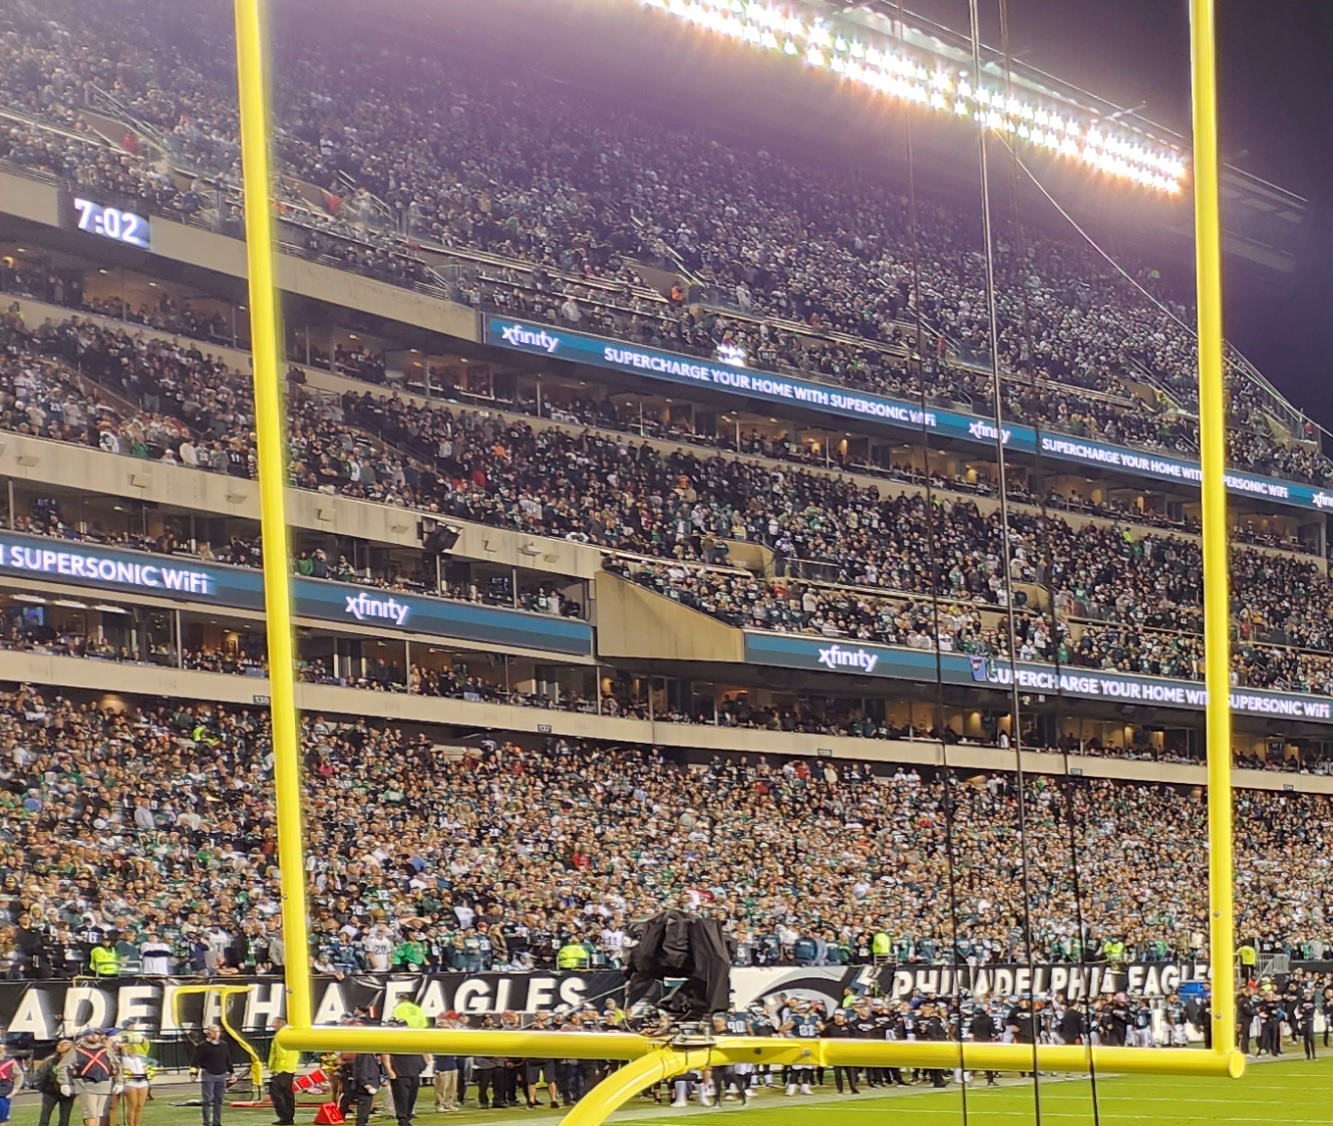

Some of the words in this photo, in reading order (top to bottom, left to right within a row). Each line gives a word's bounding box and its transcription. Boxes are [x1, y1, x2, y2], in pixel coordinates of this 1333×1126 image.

[74, 198, 140, 243] 7:02
[502, 325, 560, 353] xfinity
[604, 347, 711, 382] SUPERCHARGE
[711, 369, 751, 389] YOUR
[752, 378, 794, 400] HOME
[795, 386, 829, 406] WITH
[830, 393, 910, 422] SUPERSONIC
[969, 421, 1012, 445] xfiniy
[1042, 437, 1120, 466] SUPERCHARGE
[1121, 455, 1150, 471] YOUR
[1151, 462, 1181, 478] HOME
[1269, 484, 1289, 499] WiFi
[11, 545, 160, 586] SUPERSONIC
[161, 566, 209, 595] WiFi
[345, 592, 409, 625] xfinity
[818, 645, 879, 672] xfinity
[988, 667, 1099, 695] SUPERCHARGE
[1100, 680, 1141, 700] YOUR
[1141, 684, 1185, 704] HOME
[1185, 689, 1209, 707] WIT
[1303, 702, 1331, 719] WiFi
[382, 977, 590, 1027] EAGLES
[892, 968, 1115, 999] PHILADELPHIA
